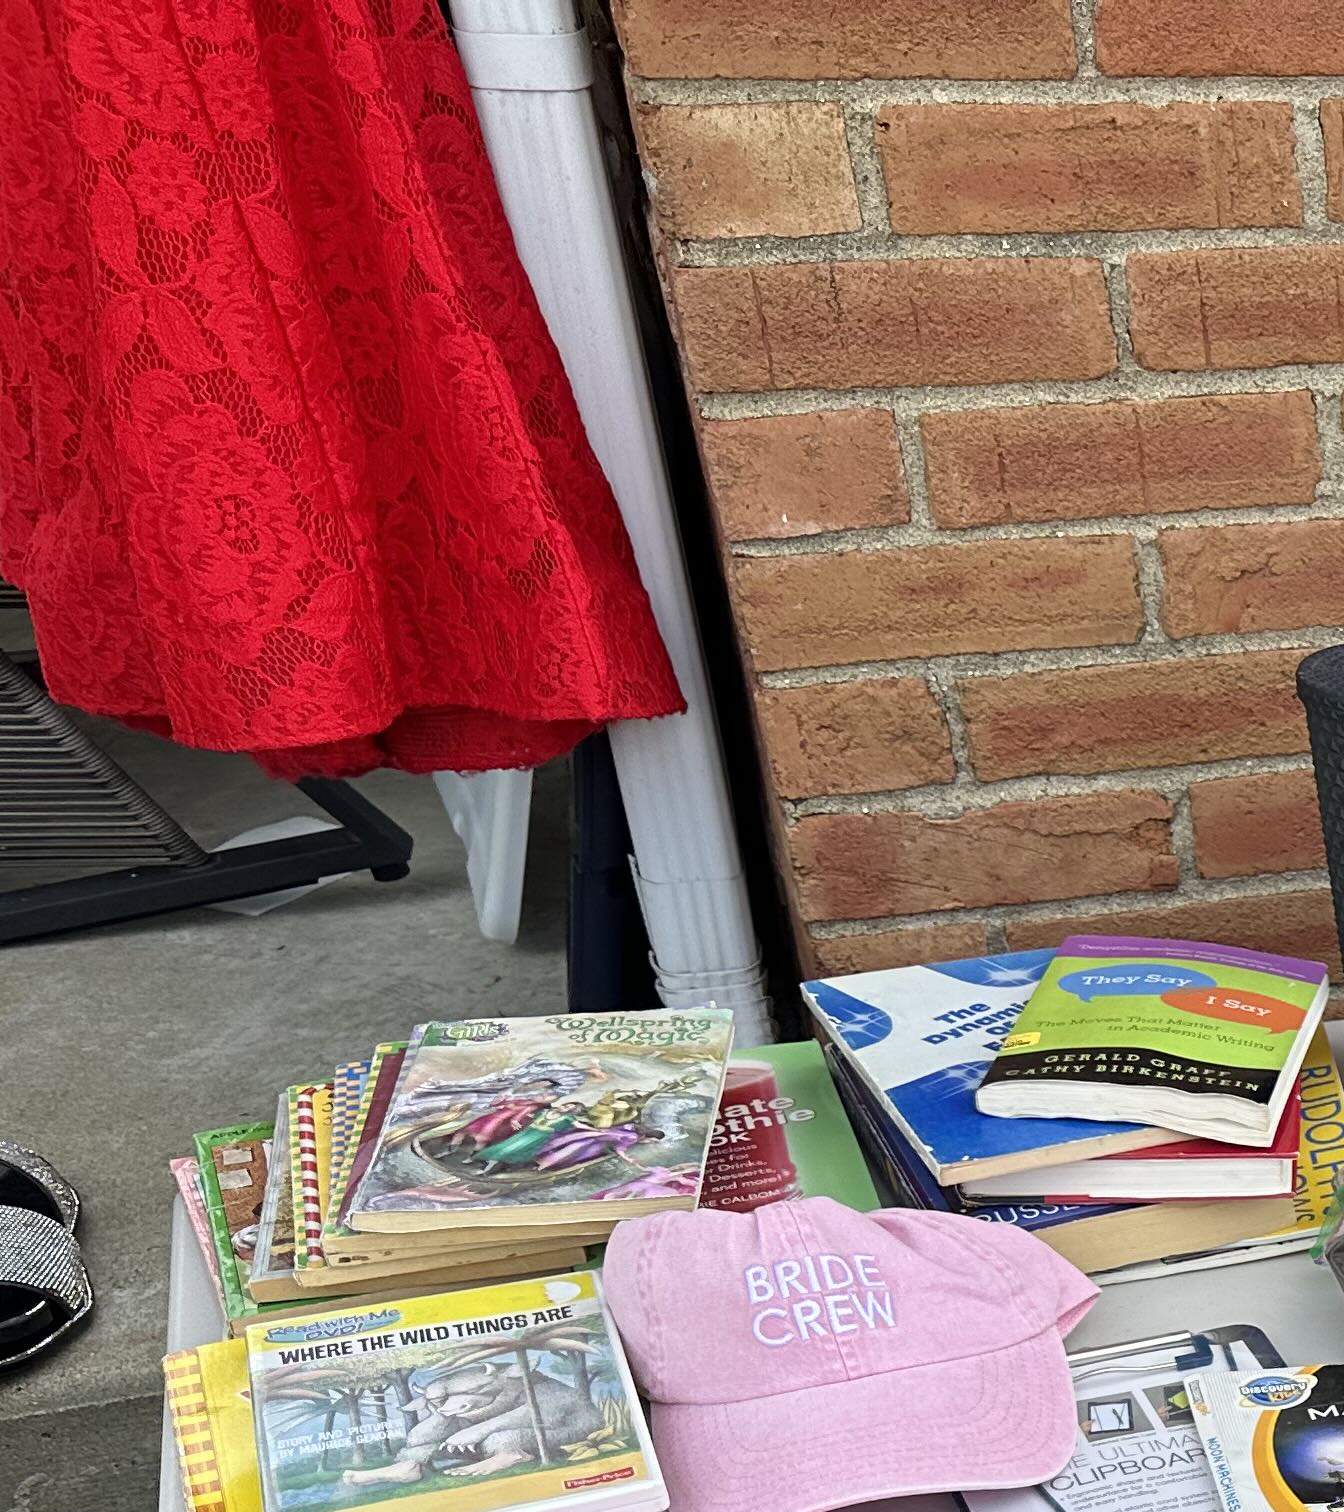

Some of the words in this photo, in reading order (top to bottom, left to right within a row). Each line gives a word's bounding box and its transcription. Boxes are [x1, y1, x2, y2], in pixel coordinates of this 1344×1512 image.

[1082, 975, 1142, 986] They
[1144, 974, 1192, 987] Say
[932, 1003, 991, 1024] The
[1205, 995, 1216, 1005] I
[1223, 999, 1272, 1017] Say
[545, 1014, 712, 1031] Wellspring
[1036, 1020, 1066, 1028] The
[1070, 1017, 1121, 1026] Moves
[1125, 1015, 1164, 1024] That
[1166, 1018, 1222, 1031] Matter
[569, 1028, 588, 1043] of
[590, 1027, 710, 1045] Magic
[1106, 1023, 1124, 1031] in
[1128, 1025, 1212, 1041] Academic
[1217, 1035, 1275, 1051] Writing
[1044, 1053, 1141, 1063] GERALD
[1150, 1058, 1233, 1077] GRAFF
[1005, 1064, 1085, 1076] CATHY
[1096, 1064, 1259, 1092] BIRKENSTEIN
[720, 1097, 794, 1119] ate
[711, 1184, 738, 1193] and
[741, 1175, 782, 1188] more!
[721, 1189, 781, 1205] CALBOM
[744, 1253, 886, 1305] BRIDE
[752, 1290, 897, 1347] CREW
[279, 1340, 352, 1365] WHERE
[357, 1334, 395, 1351] THE
[399, 1327, 449, 1346] WILD
[455, 1314, 529, 1337] THINGS
[533, 1305, 574, 1324] ARE
[304, 1323, 364, 1341] DVD!
[277, 1435, 313, 1449] STORY
[319, 1429, 343, 1442] AND
[279, 1448, 295, 1459] BY
[1207, 1437, 1224, 1468] MOON
[1216, 1463, 1242, 1512] MACHINES
